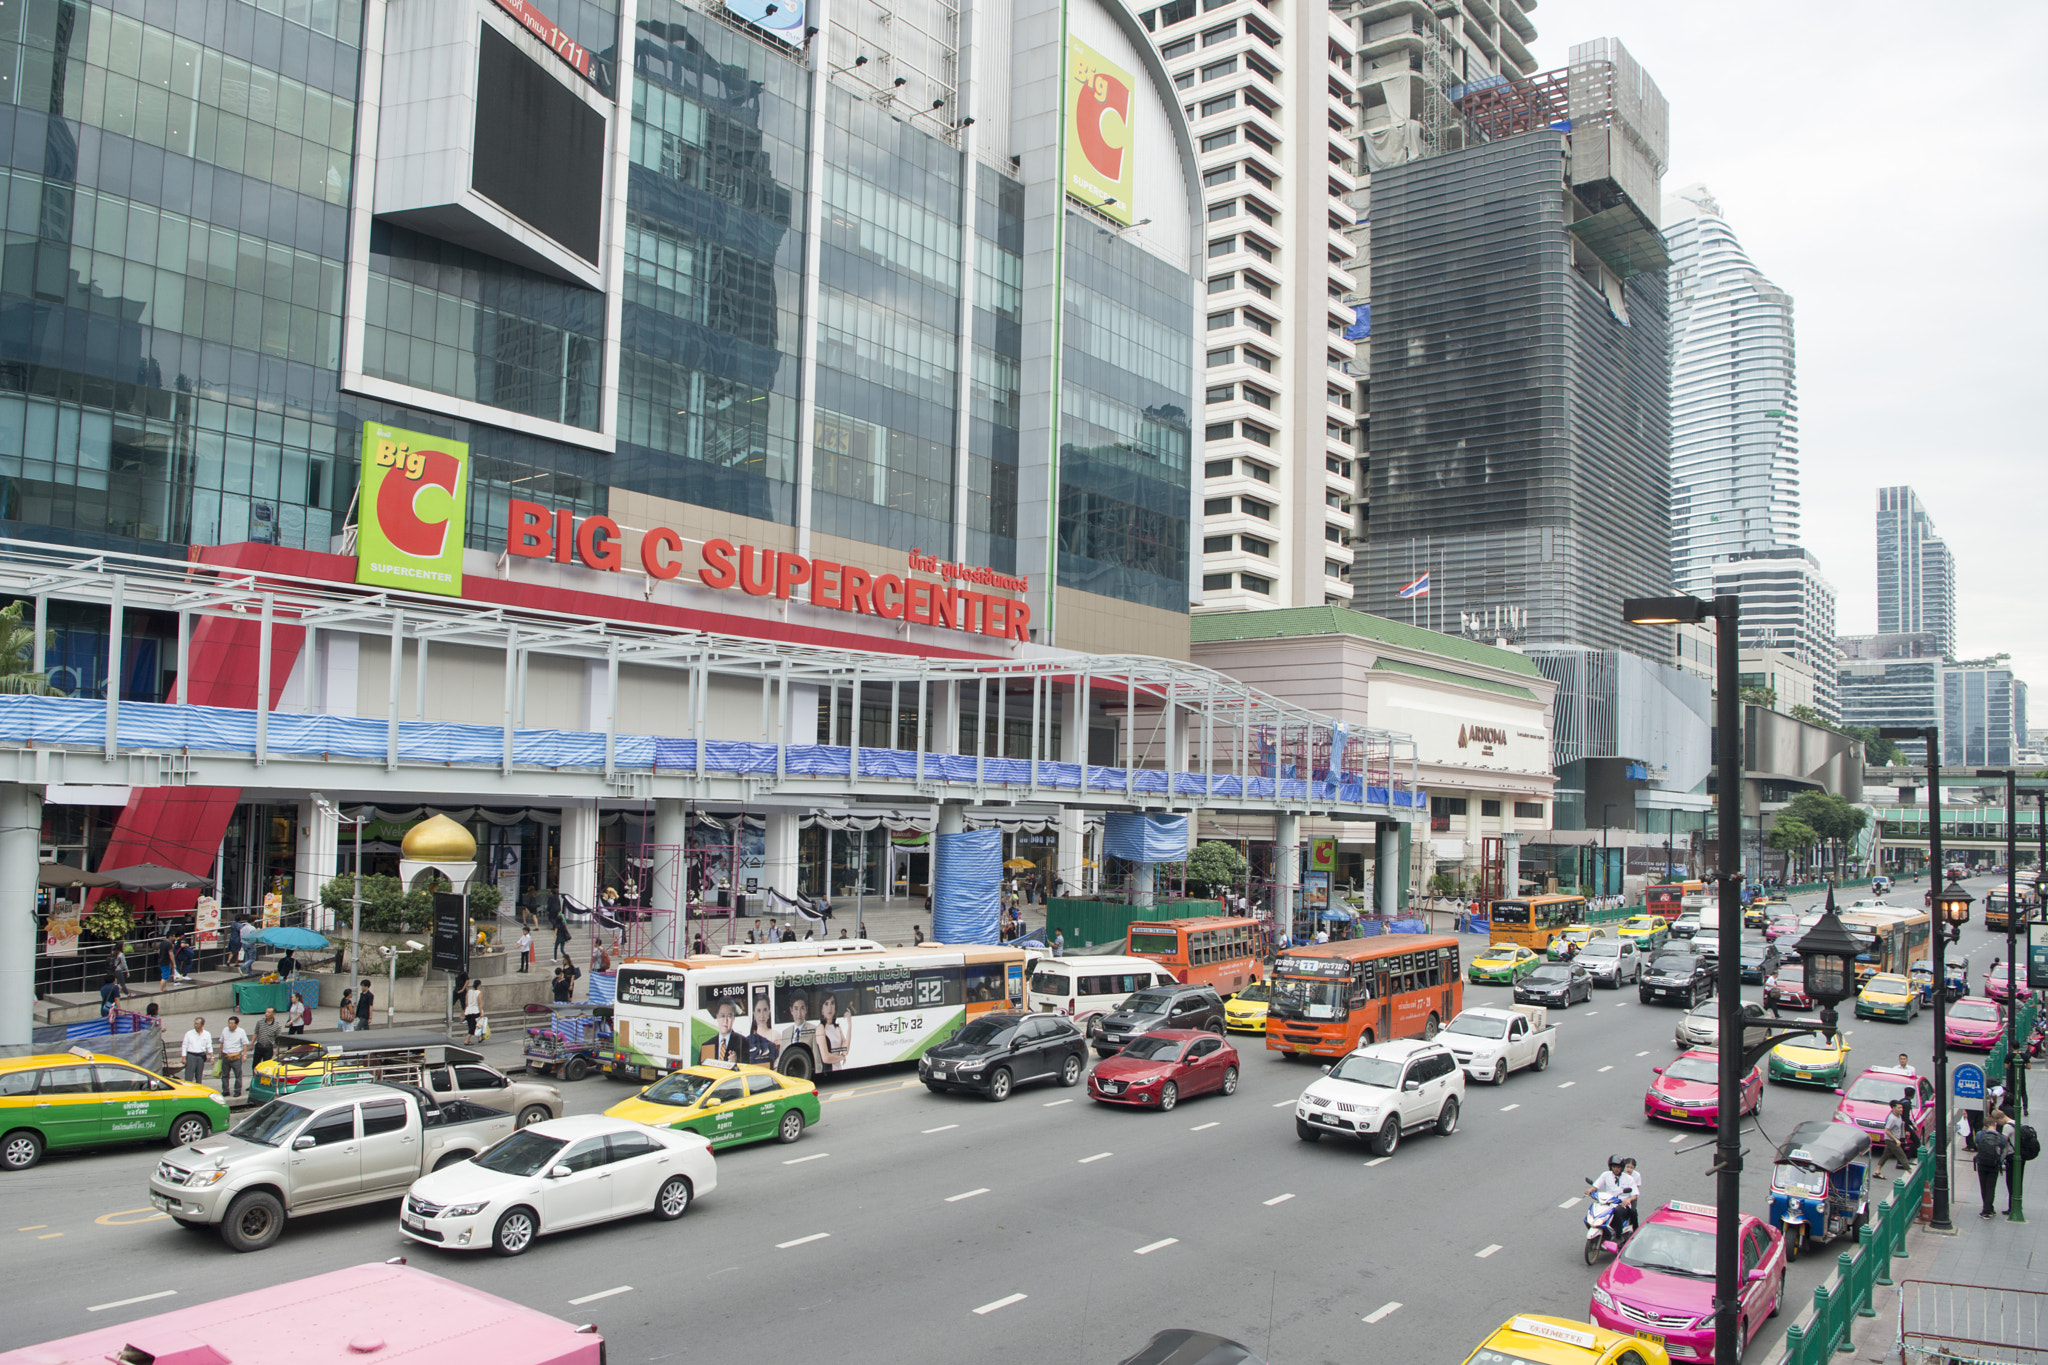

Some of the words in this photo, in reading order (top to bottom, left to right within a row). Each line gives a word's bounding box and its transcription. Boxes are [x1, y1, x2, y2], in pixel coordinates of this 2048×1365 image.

[551, 27, 583, 69] 1711
[1073, 54, 1109, 104] Big
[1076, 73, 1131, 184] C
[375, 439, 427, 481] Big
[376, 450, 462, 559] C
[370, 562, 452, 583] SUPERCENTER
[506, 498, 622, 572] BIG
[641, 527, 683, 580] C
[698, 538, 1032, 642] SUPERCENTER
[1030, 833, 1044, 844] bon
[1302, 961, 1316, 970] 77
[1343, 963, 1350, 972] 3
[656, 981, 674, 997] 32
[713, 986, 745, 997] 8-55105
[875, 993, 914, 1009] เปิดช่อง
[918, 980, 942, 1004] 32
[655, 1032, 664, 1040] 32
[901, 1021, 909, 1030] TV
[910, 1018, 923, 1030] 32
